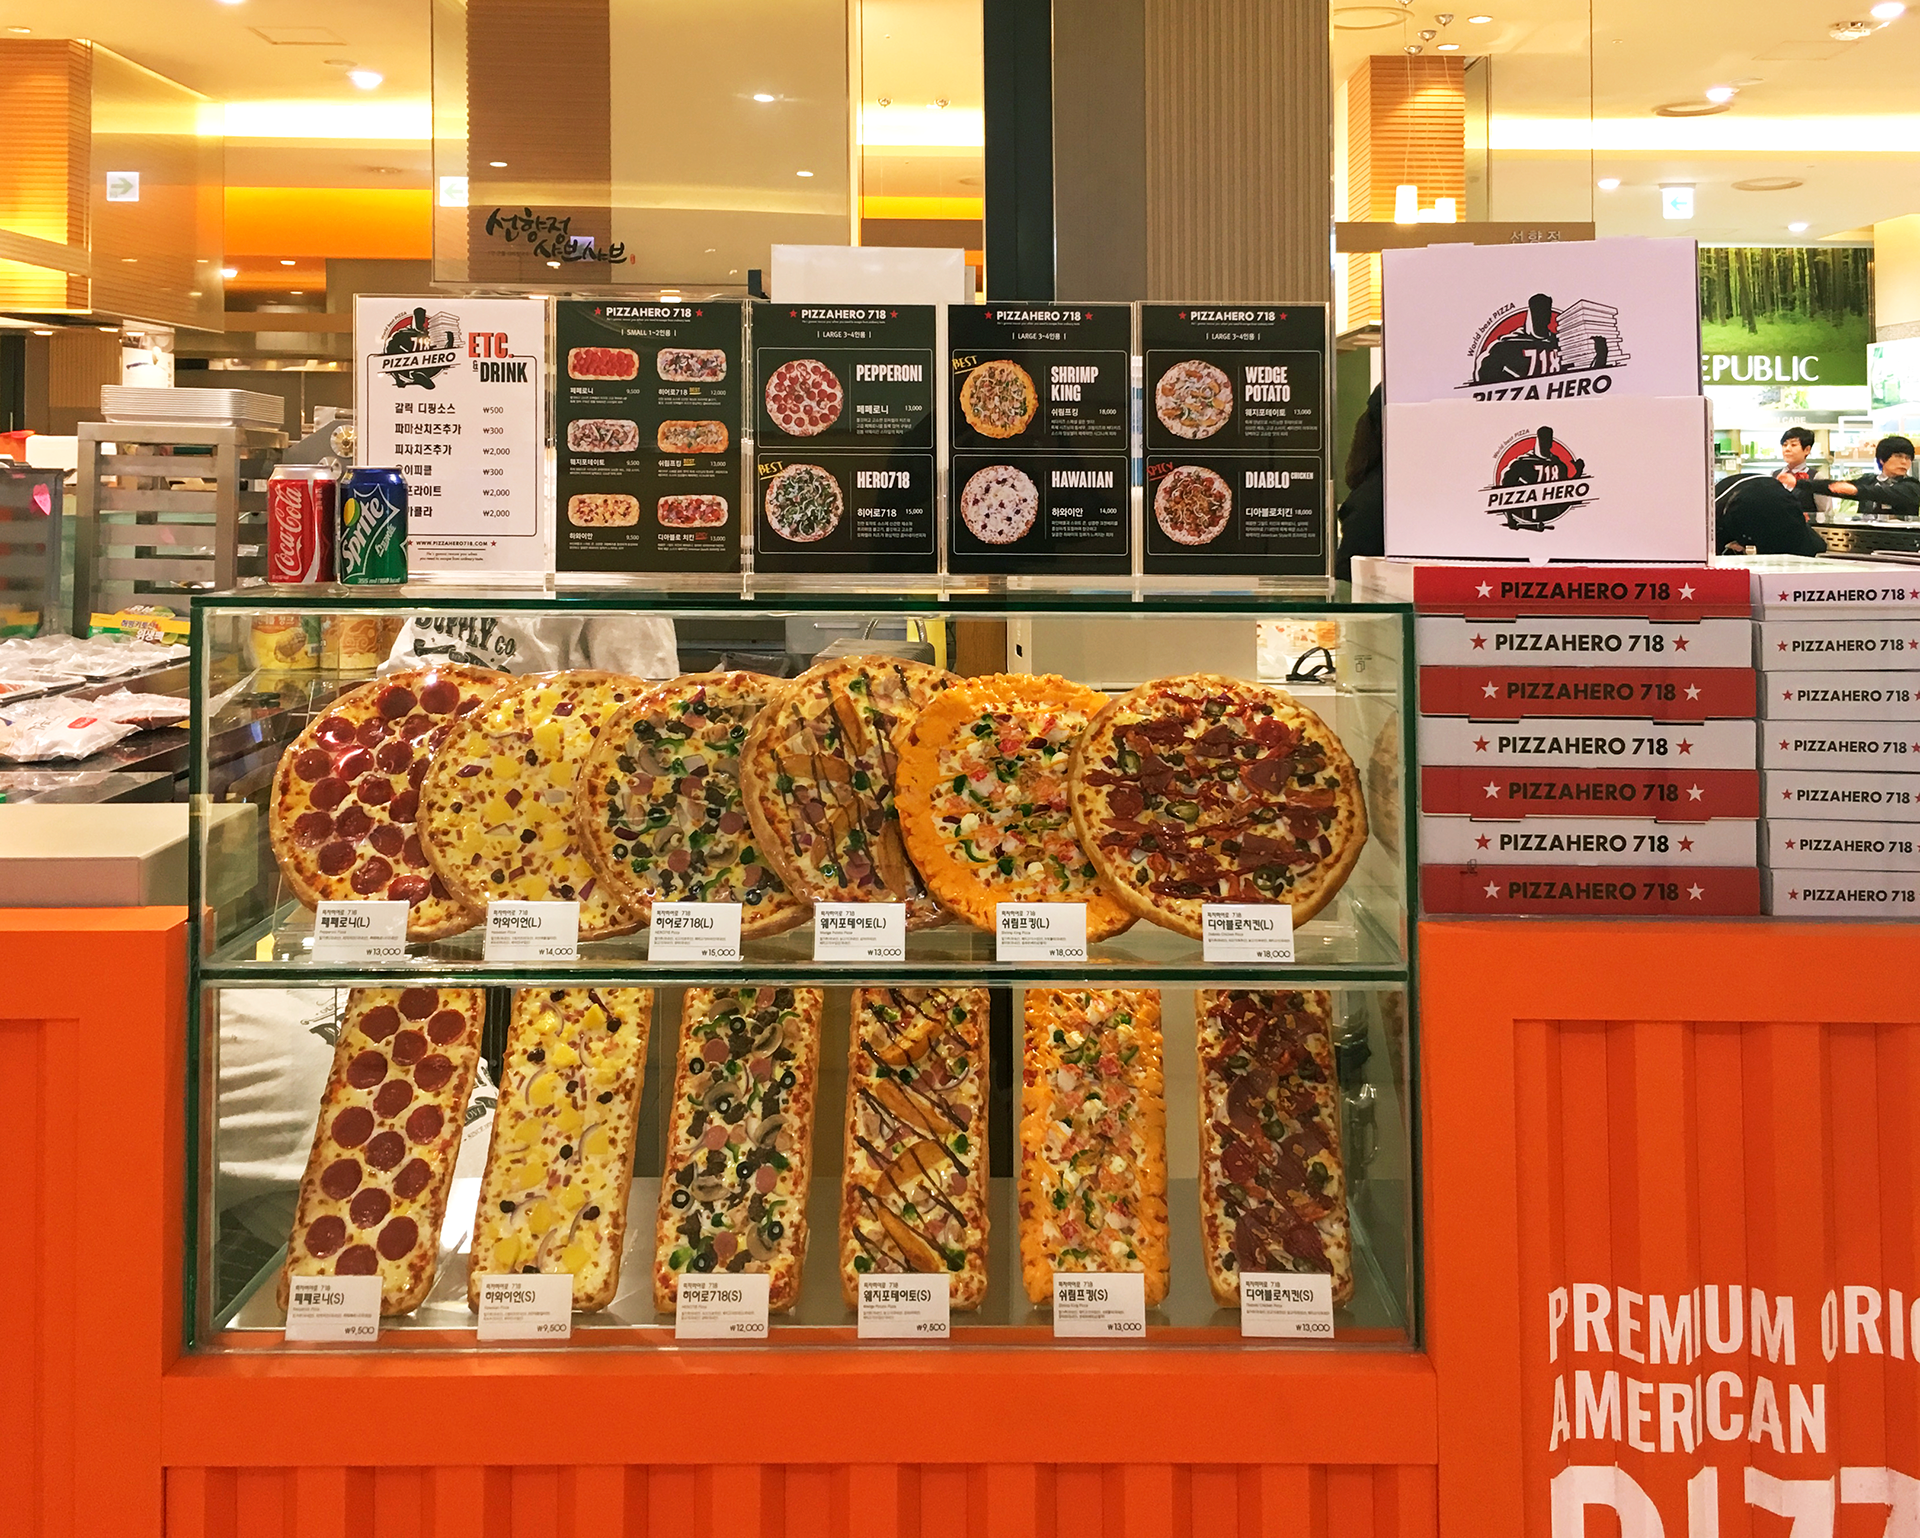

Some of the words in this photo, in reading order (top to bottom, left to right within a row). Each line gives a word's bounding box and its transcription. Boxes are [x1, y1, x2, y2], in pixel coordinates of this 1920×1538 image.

[606, 307, 670, 318] PIZZAHERO
[673, 308, 692, 318] 718
[801, 309, 865, 319] PIZZAHERO
[868, 310, 886, 319] 718
[996, 311, 1060, 320] PIZZAHERO
[1062, 311, 1081, 321] 718
[1190, 311, 1254, 321] PIZZAHERO
[1257, 312, 1276, 321] 718
[1467, 334, 1480, 357] World
[1480, 319, 1493, 334] best
[1492, 302, 1516, 320] PIZZA
[468, 332, 514, 358] ETC.
[382, 356, 419, 369] PIZZA
[422, 352, 456, 364] HERO
[952, 355, 977, 370] BEST
[480, 362, 528, 383] DRINK
[856, 364, 923, 382] PEPPERONI
[1051, 366, 1099, 383] SHRIMP
[1245, 366, 1288, 383] WEDGE
[1051, 384, 1081, 402] KING
[1245, 385, 1290, 402] POTATO
[1546, 375, 1612, 400] HERO
[395, 402, 414, 414] 갈릭
[418, 402, 456, 414] 디핑소스
[482, 406, 504, 414] ₩500
[856, 405, 889, 414] 페페로니
[395, 423, 462, 435] 파마산치즈추가
[482, 427, 504, 435] ₩300
[395, 444, 452, 455] 피자치즈추가
[482, 448, 510, 456] ₩2,000
[482, 468, 504, 476] ₩300
[758, 461, 783, 476] BEST
[857, 471, 910, 488] HERO718
[1052, 471, 1114, 488] HAWAIIAN
[1245, 471, 1290, 488] DIABLO
[482, 489, 510, 497] ₩2,000
[1488, 489, 1538, 507] PIZZA
[1542, 482, 1590, 500] HERO
[482, 510, 510, 518] ₩2,000
[857, 508, 897, 517] 히어로718
[1052, 508, 1083, 517] 하와이안
[1245, 508, 1293, 517] 디아블로치킨
[342, 497, 384, 574] Sprite
[1500, 582, 1628, 600] PIZZAHERO
[1634, 582, 1670, 601] 718
[1793, 589, 1877, 602] PIZZAHERO
[1880, 588, 1905, 601] 718
[1495, 634, 1622, 652] PIZZAHERO
[1628, 635, 1664, 653] 718
[1792, 639, 1876, 652] PIZZAHERO
[1879, 639, 1904, 651] 718
[1507, 683, 1634, 701] PIZZAHERO
[1640, 684, 1676, 701] 718
[1797, 689, 1881, 702] PIZZAHERO
[1885, 689, 1910, 702] 718
[1498, 736, 1625, 754] PIZZAHERO
[1632, 737, 1668, 756] 718
[1794, 739, 1879, 754] PIZZAHERO
[1882, 741, 1907, 754] 718
[1508, 783, 1636, 800] PIZZAHERO
[1643, 783, 1679, 801] 718
[1796, 789, 1881, 804] PIZZAHERO
[1885, 790, 1910, 804] 718
[1500, 834, 1626, 852] PIZZAHERO
[1632, 835, 1669, 853] 718
[1799, 838, 1884, 852] PIZZAHERO
[1887, 840, 1913, 854] 718
[1508, 882, 1636, 900] PIZZAHERO
[1643, 883, 1679, 900] 718
[1803, 888, 1887, 902] PIZZAHERO
[1890, 889, 1915, 902] 718
[656, 918, 714, 929] 히어로718(L)
[820, 918, 887, 929] 웨지포테이토(L)
[1002, 918, 1050, 929] 쉬림프킹(L)
[366, 948, 401, 956] ₩13,000
[539, 948, 573, 956] ₩14,000
[702, 949, 736, 957] ₩15,000
[867, 948, 902, 957] ₩13,000
[1049, 949, 1084, 957] ₩18,000
[1257, 950, 1291, 958] ₩18,000
[683, 1290, 742, 1302] 히어로718(S)
[864, 1290, 931, 1302] 웨지포테이토(S)
[1059, 1289, 1108, 1302] 쉬림프킹(S)
[345, 1326, 375, 1335] ₩9,500
[537, 1324, 567, 1333] ₩9,500
[730, 1324, 764, 1332] ₩12,000
[916, 1323, 946, 1332] ₩9,500
[1107, 1323, 1142, 1332] ₩13,000
[1296, 1324, 1330, 1333] ₩13,000
[1548, 1282, 1796, 1366] PREMIUM
[1820, 1286, 1920, 1364] ORI
[1548, 1370, 1826, 1454] AMERICAN
